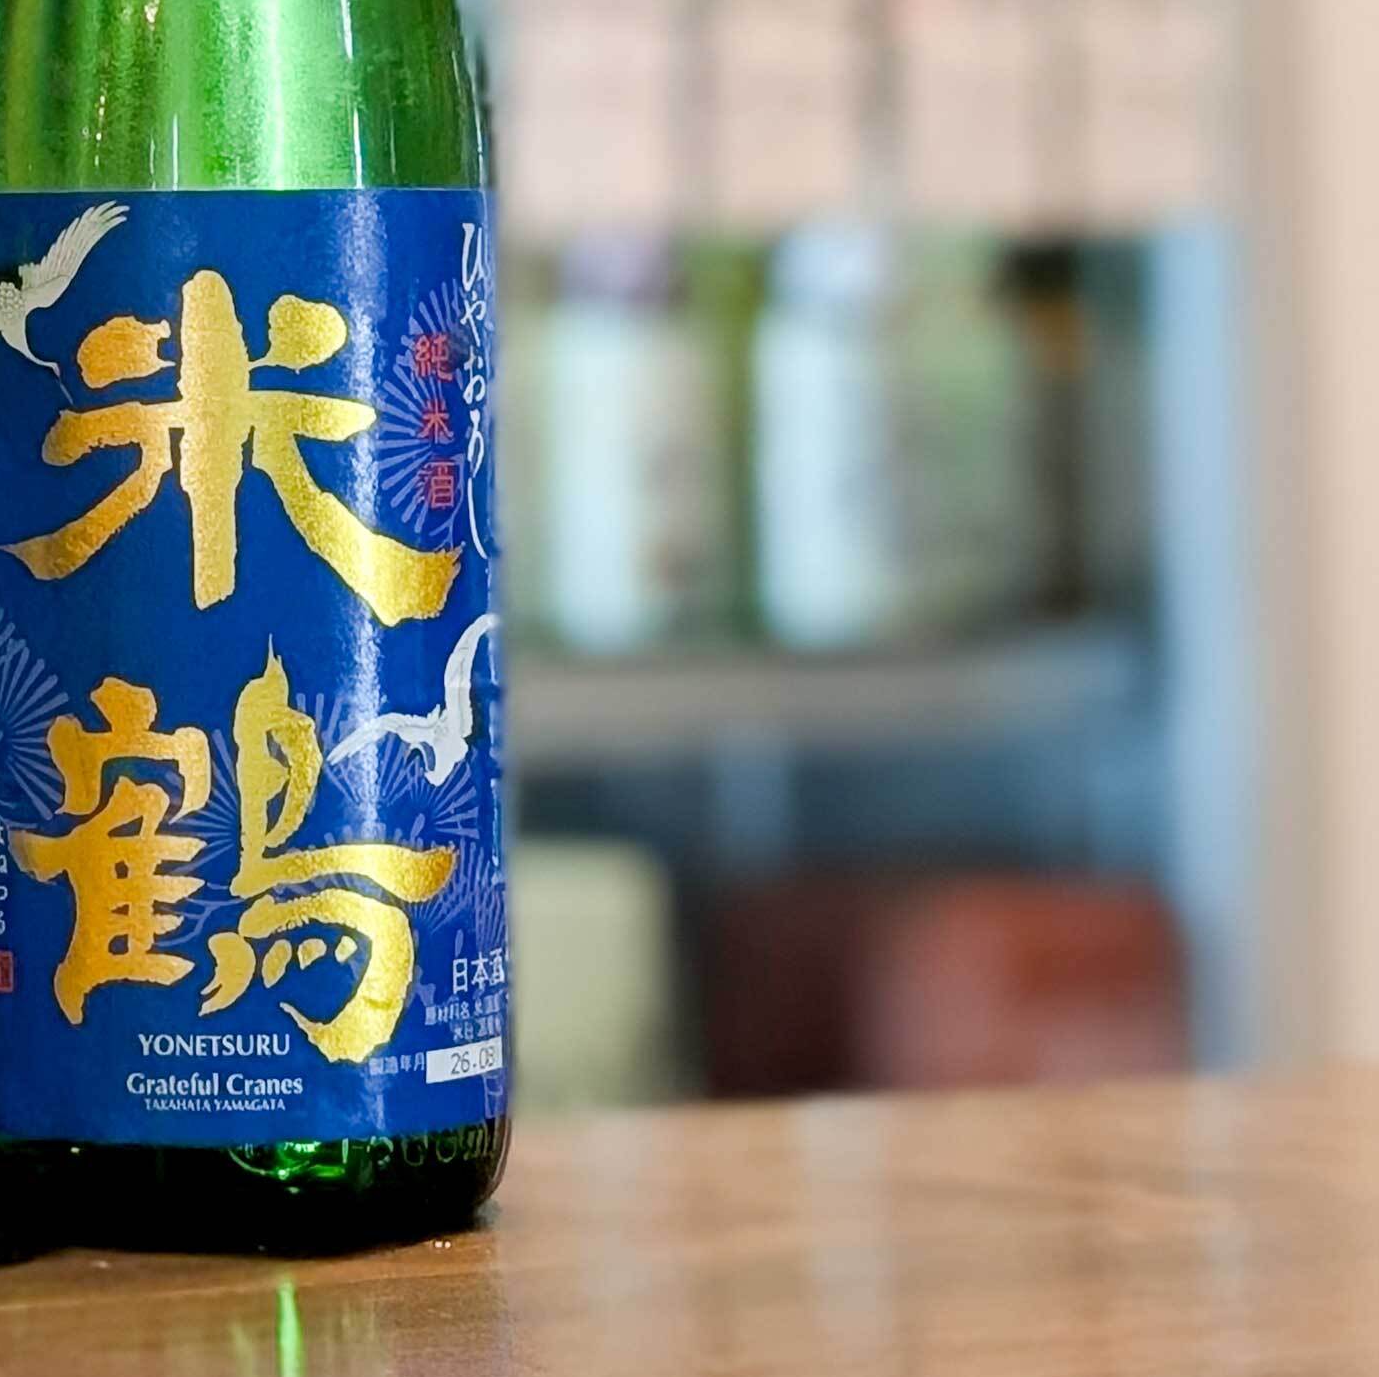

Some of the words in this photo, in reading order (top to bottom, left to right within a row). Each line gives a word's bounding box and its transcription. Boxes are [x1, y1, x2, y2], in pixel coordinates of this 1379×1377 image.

[460, 222, 488, 560] ひやおろし
[414, 332, 456, 509] 純米酒
[138, 1033, 290, 1057] YONETSURU
[127, 1072, 220, 1096] Grateful
[226, 1073, 303, 1096] Cranes
[144, 1098, 211, 1111] TAKAHATA
[214, 1098, 286, 1111] YAMAGATA
